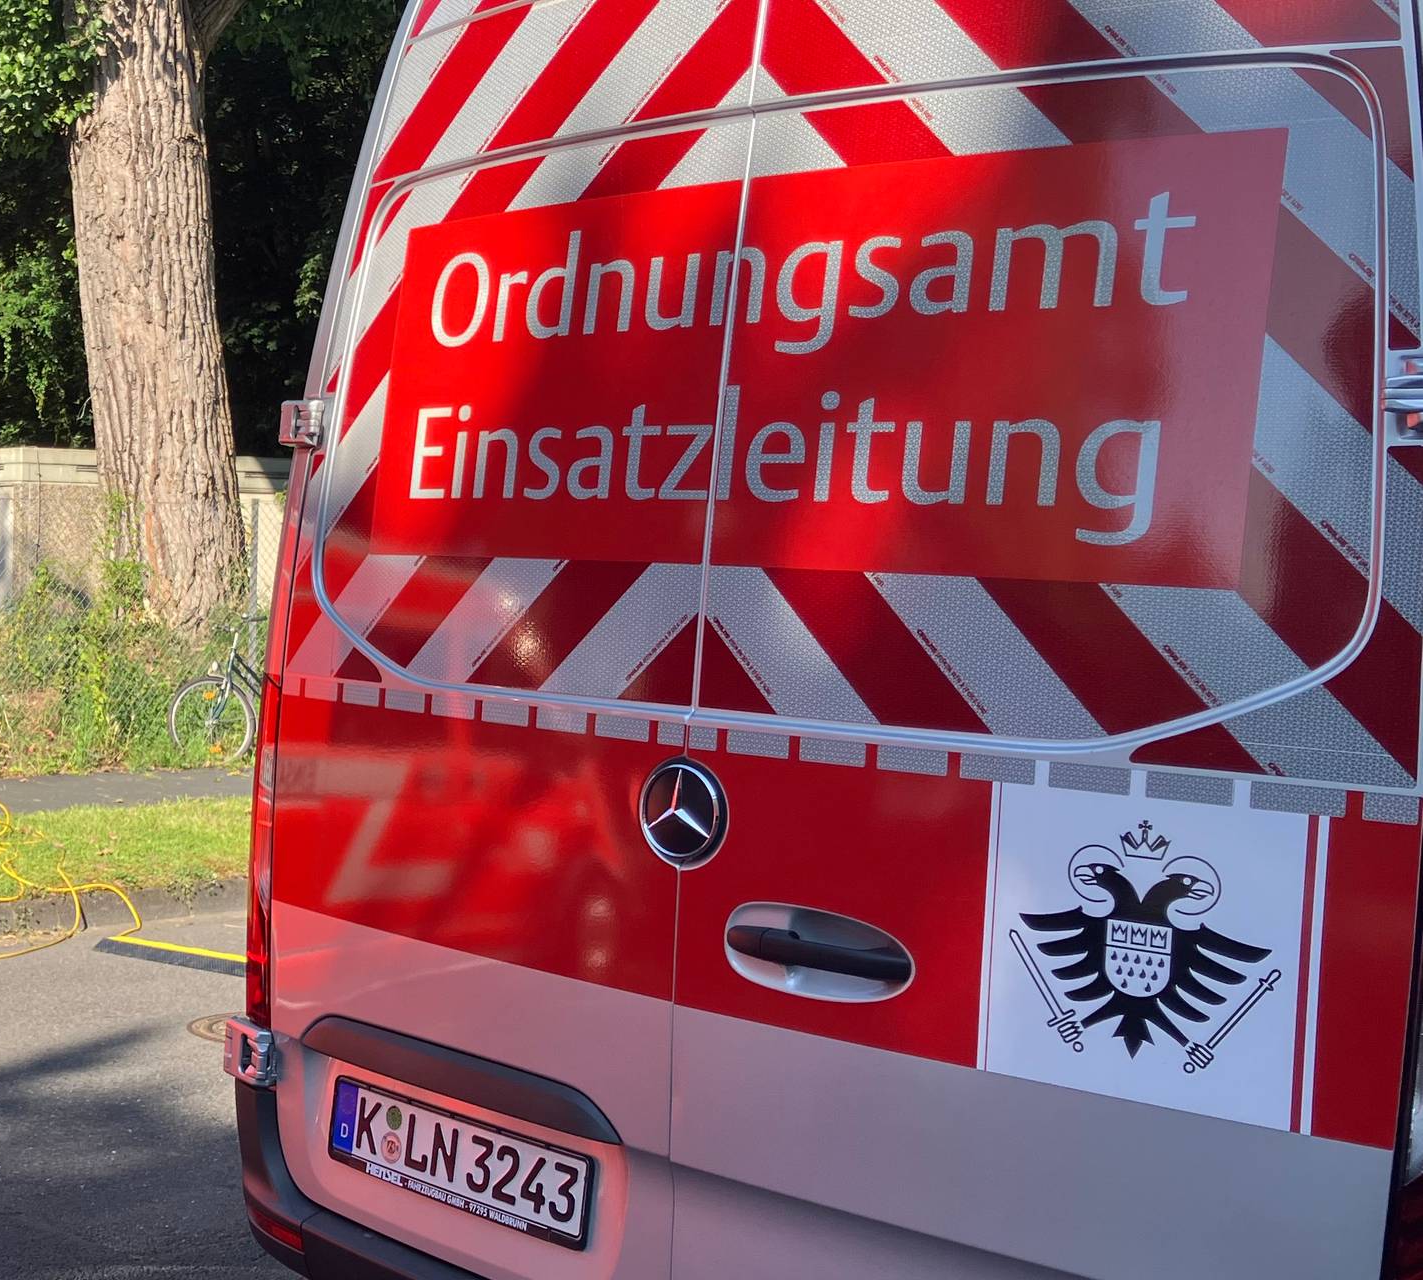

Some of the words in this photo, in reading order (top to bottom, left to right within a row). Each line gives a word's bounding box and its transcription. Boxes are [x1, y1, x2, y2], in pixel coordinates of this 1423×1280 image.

[431, 191, 1197, 355] Ordnungsamt
[409, 385, 1162, 546] Einsatzleitung
[340, 1123, 349, 1139] D
[355, 1096, 382, 1156] K
[404, 1113, 460, 1184] LN
[465, 1134, 579, 1224] 3243
[488, 1208, 529, 1232] WALDBRUNN
